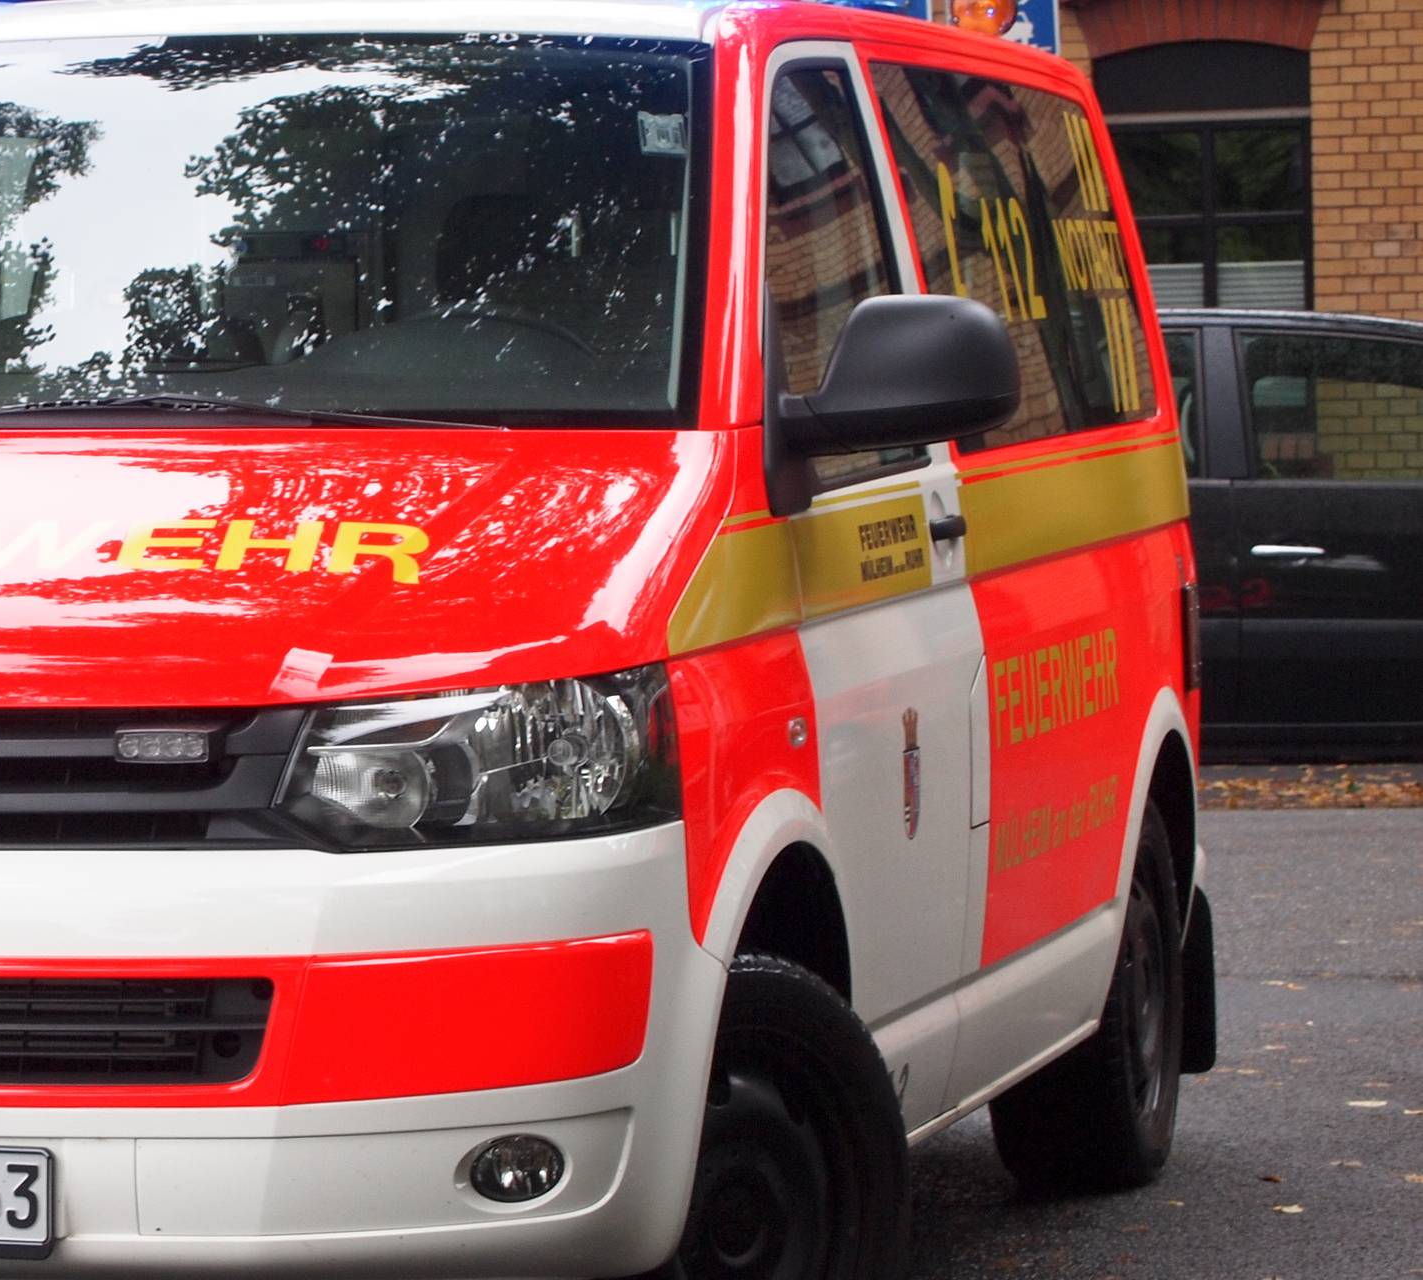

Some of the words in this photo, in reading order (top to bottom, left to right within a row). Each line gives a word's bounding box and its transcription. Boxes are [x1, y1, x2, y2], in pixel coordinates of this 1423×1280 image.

[981, 197, 1047, 322] 112
[1051, 218, 1130, 291] NOTARZT
[858, 514, 919, 552] FEUERWEHR
[992, 627, 1120, 751] FEUERWEHR
